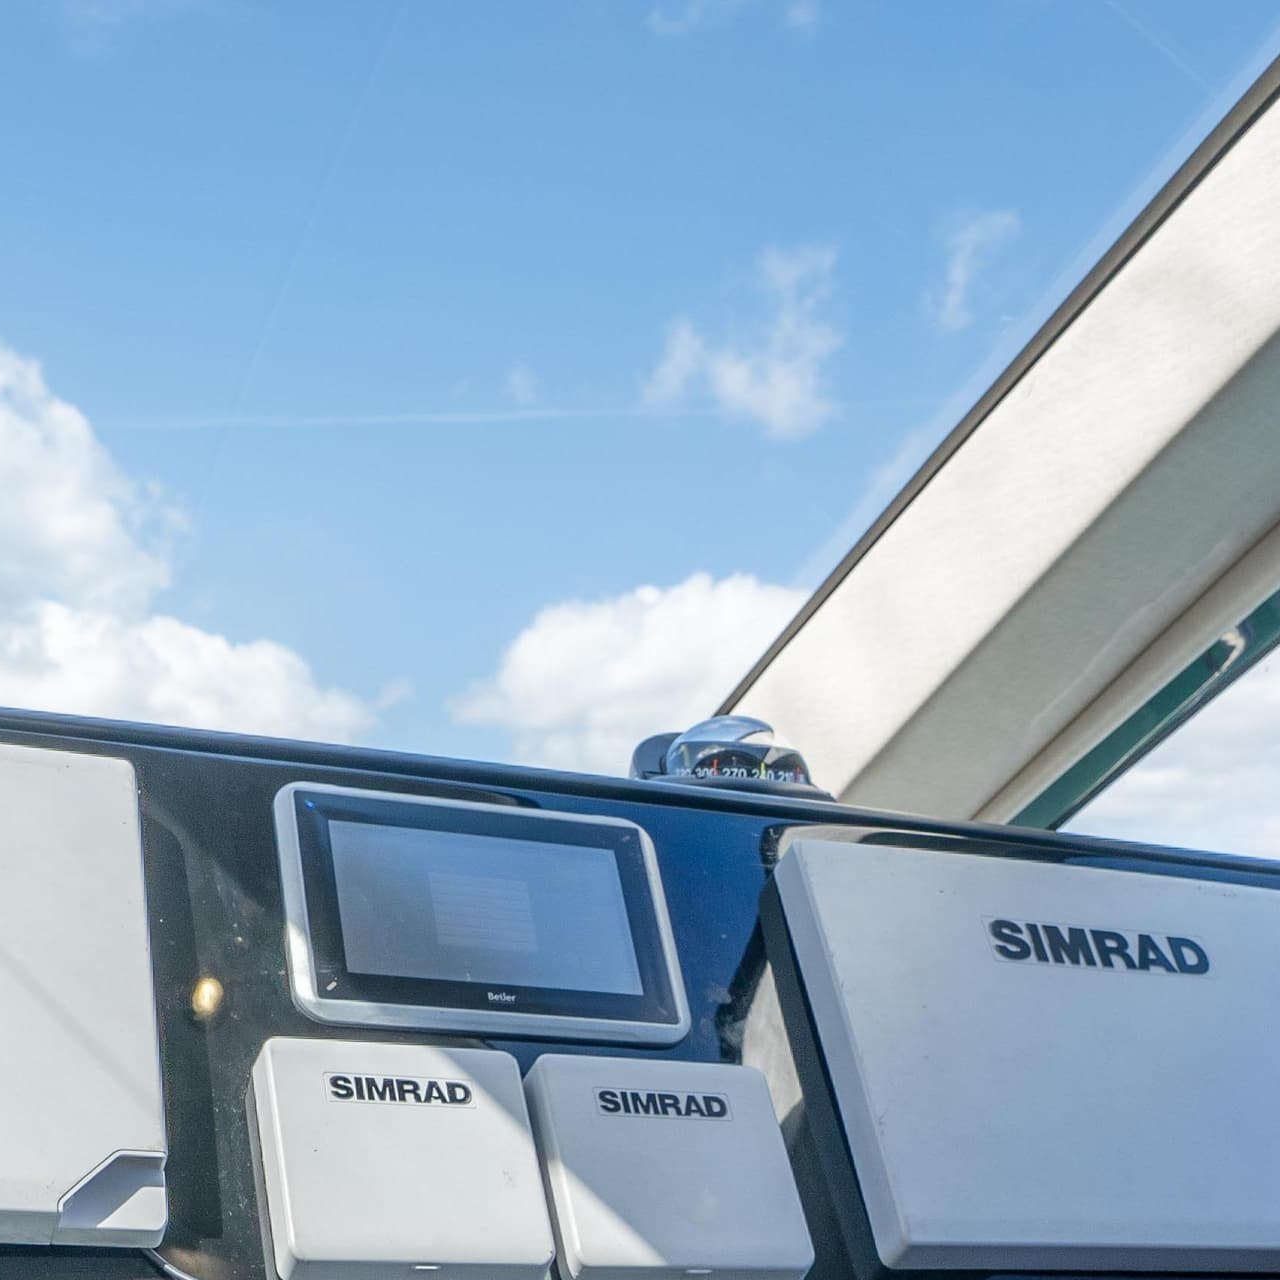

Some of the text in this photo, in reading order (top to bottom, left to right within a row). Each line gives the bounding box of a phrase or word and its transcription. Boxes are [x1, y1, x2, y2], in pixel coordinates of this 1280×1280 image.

[722, 768, 747, 778] 270
[752, 768, 774, 780] 20
[989, 919, 1210, 975] SIMRAD
[329, 1075, 472, 1105] SIMRAD
[598, 1090, 727, 1118] SIMRAD
